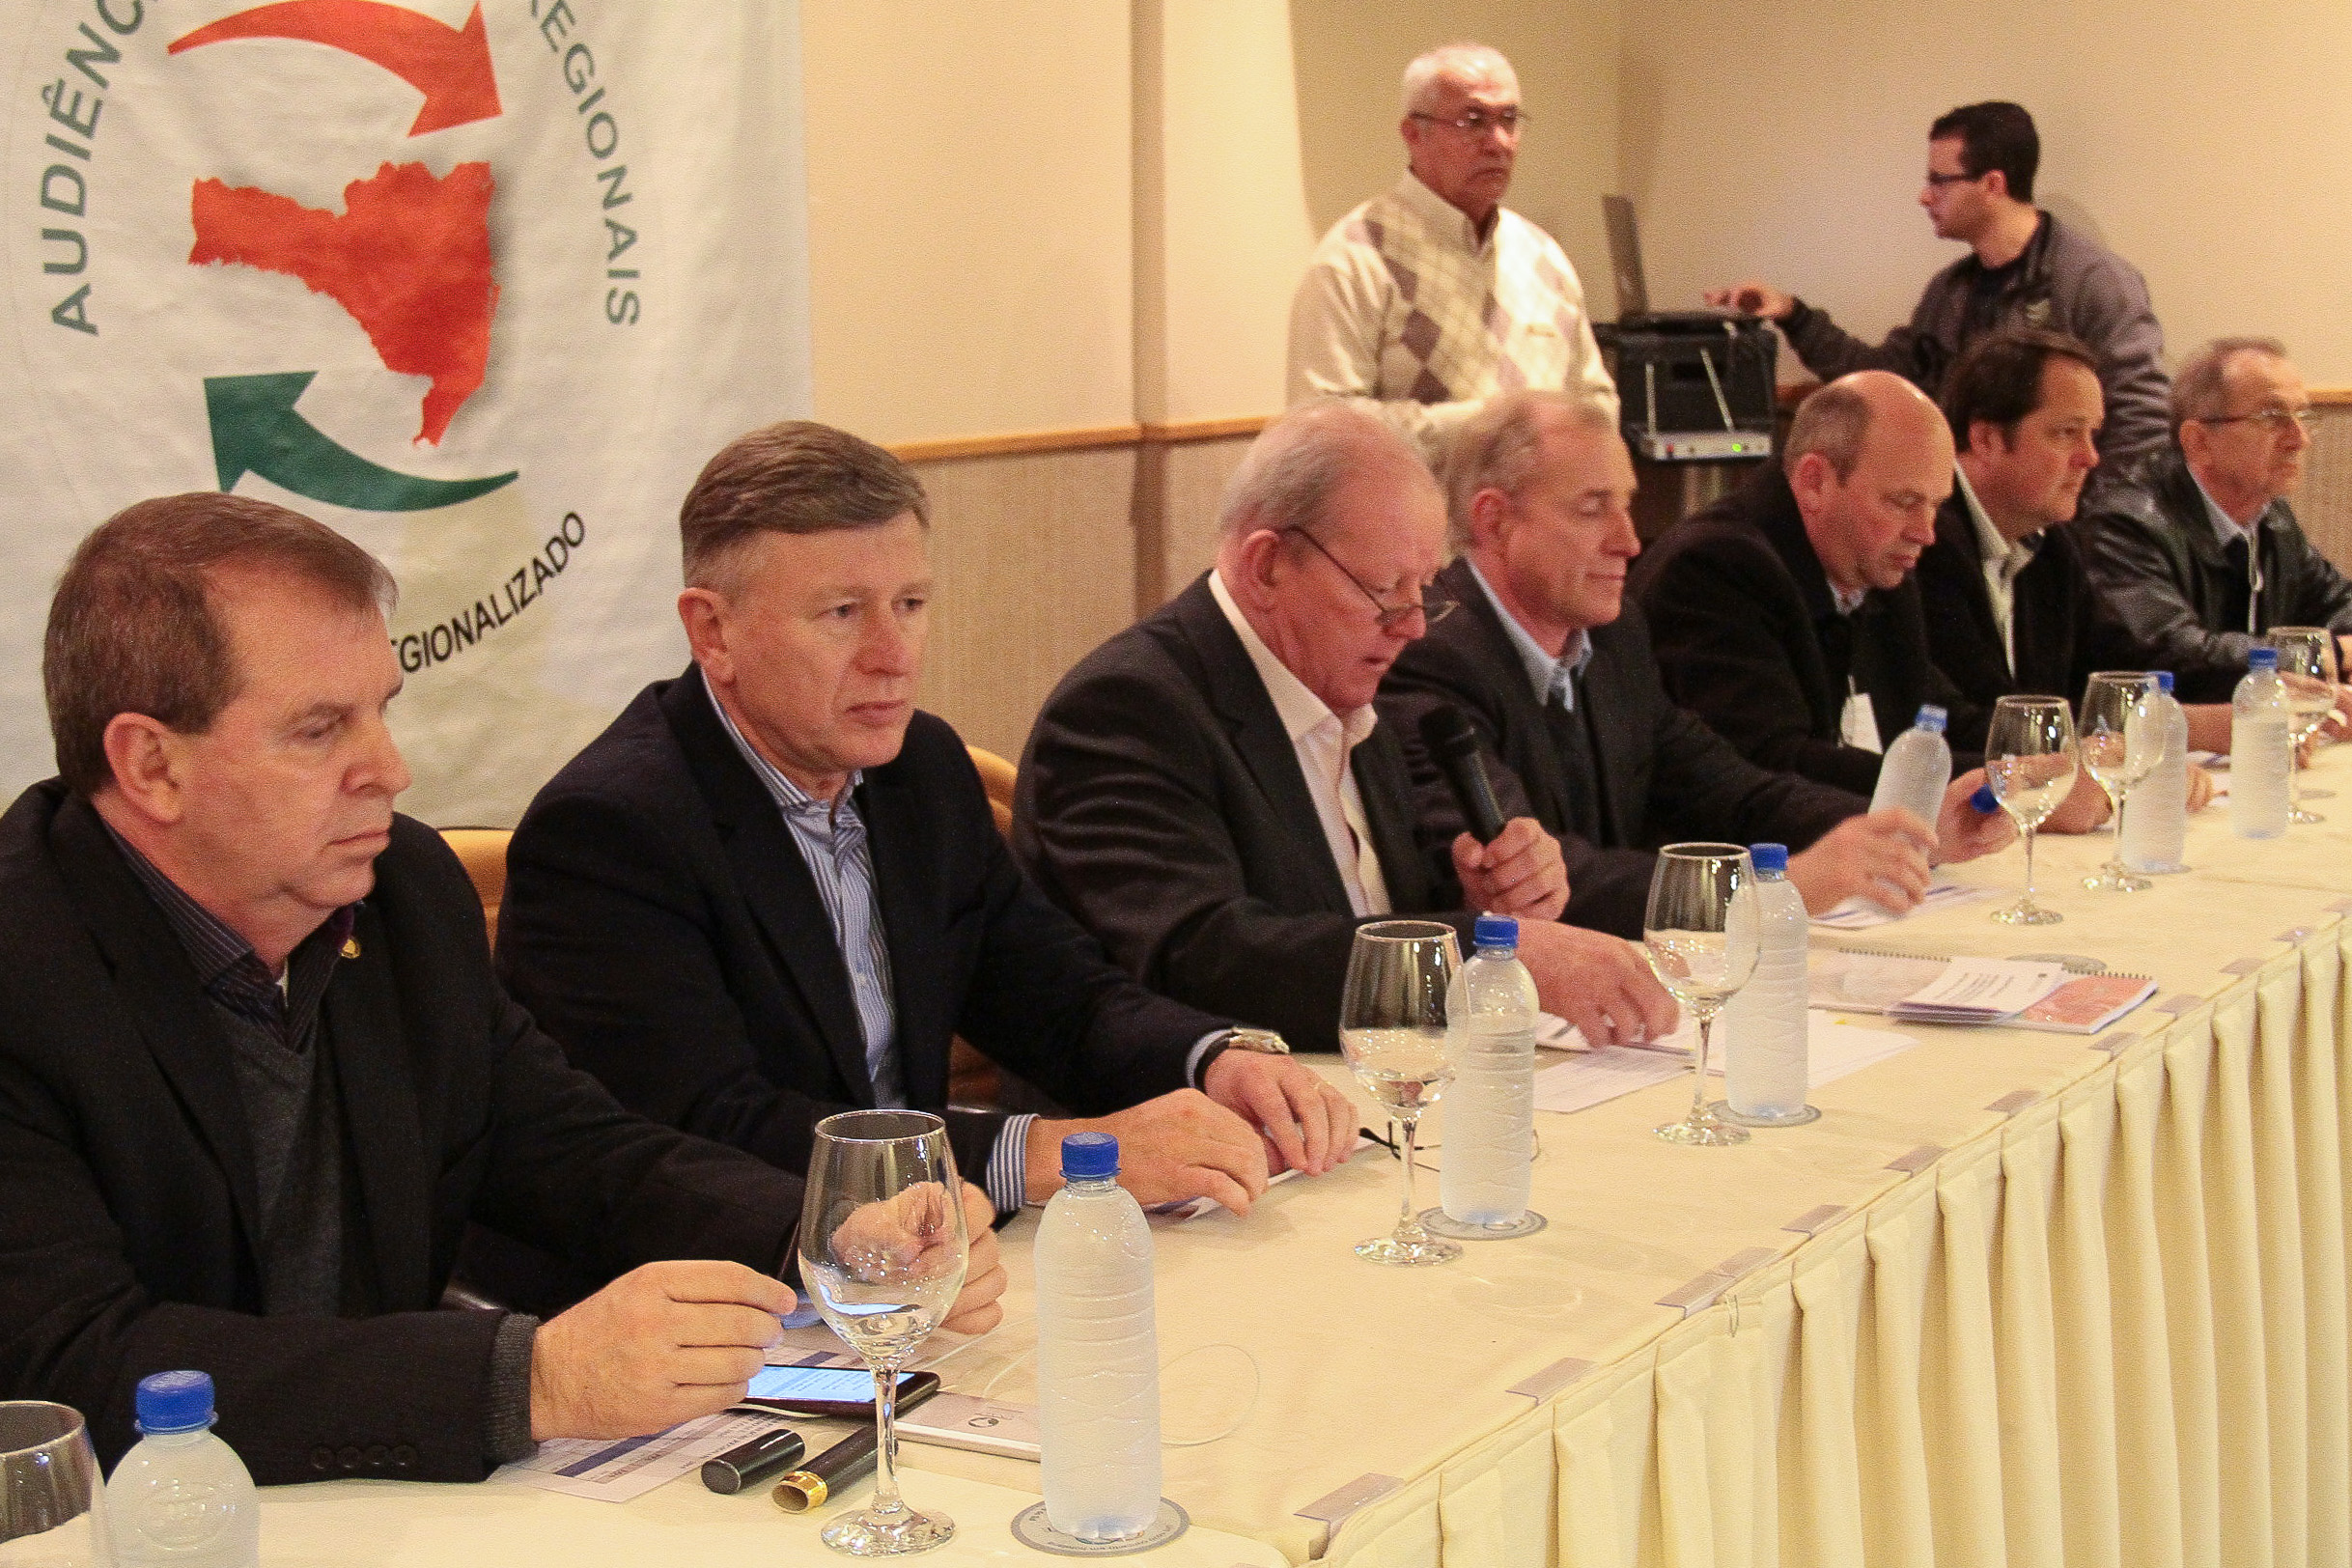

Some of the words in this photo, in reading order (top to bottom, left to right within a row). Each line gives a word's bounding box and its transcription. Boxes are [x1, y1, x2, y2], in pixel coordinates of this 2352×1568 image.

[40, 0, 157, 337] AUDIÊNC
[531, 0, 641, 326] EGIONAIS
[390, 511, 585, 673] GIONALIZADO
